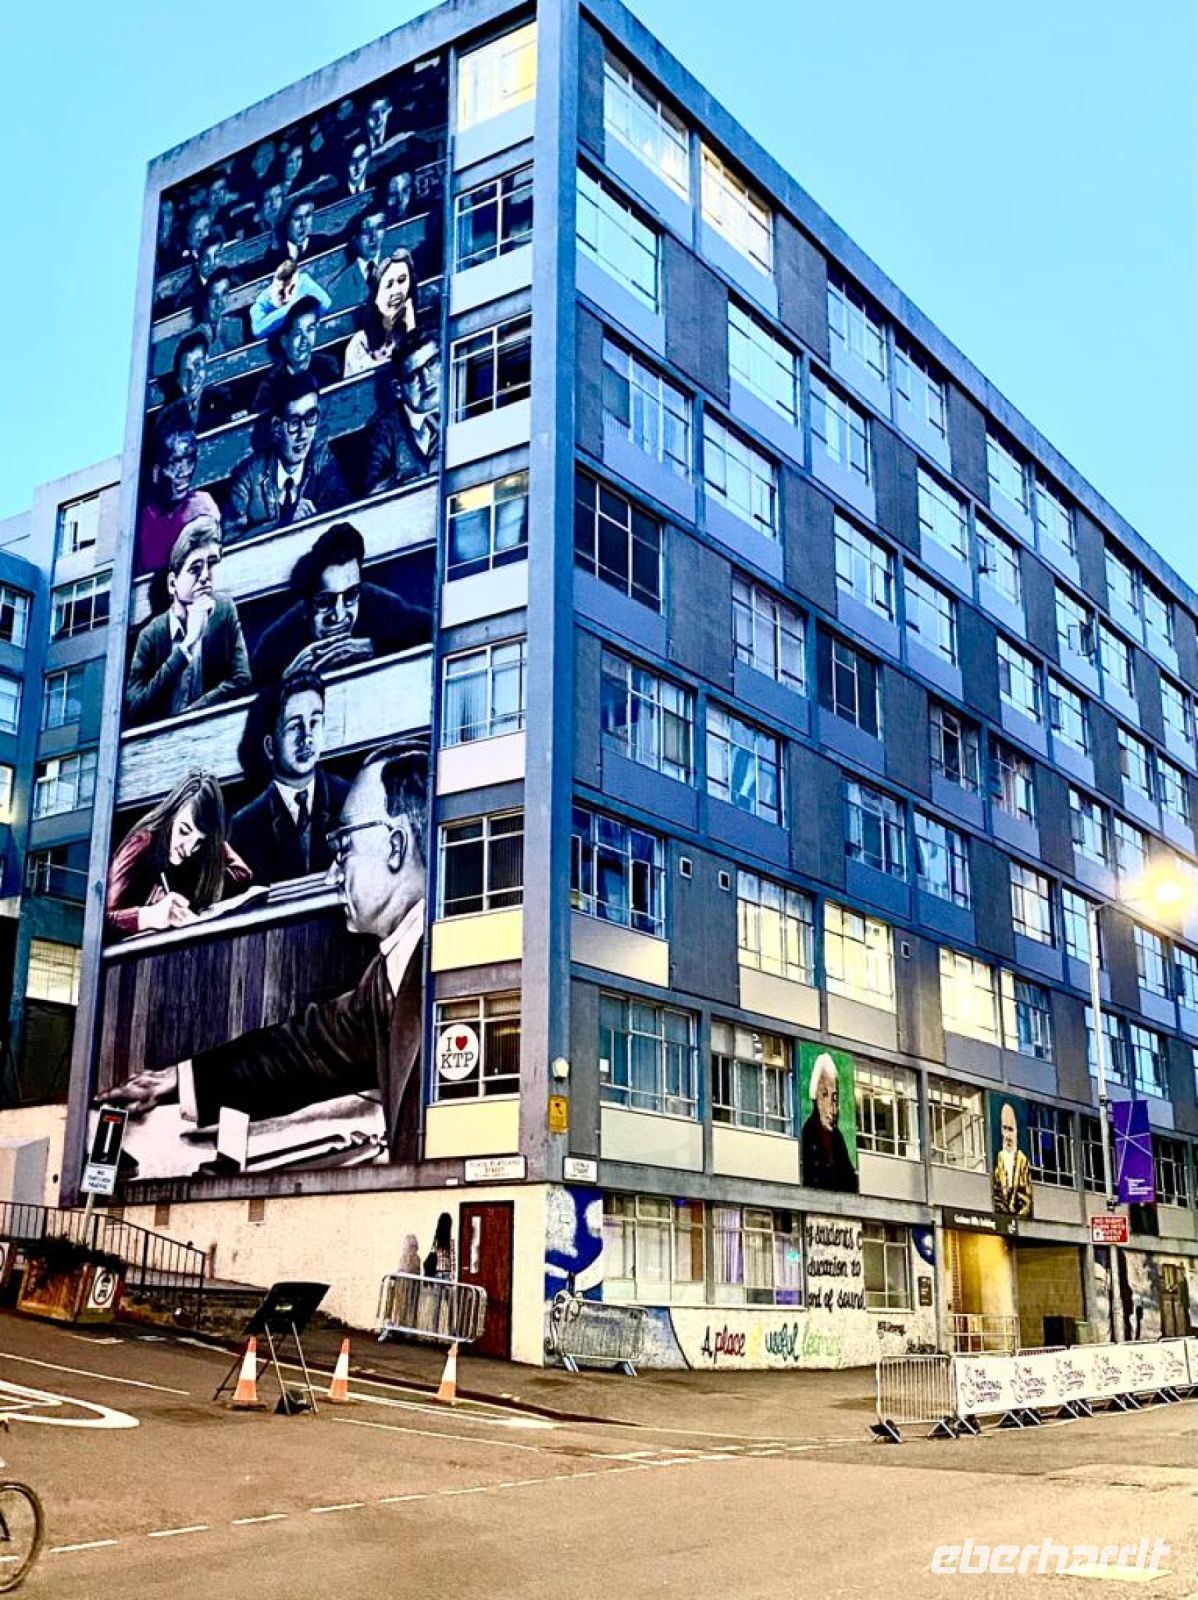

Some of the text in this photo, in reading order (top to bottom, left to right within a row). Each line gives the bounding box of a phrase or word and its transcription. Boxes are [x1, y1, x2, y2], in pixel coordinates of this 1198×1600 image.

[447, 1036, 452, 1052] I
[441, 1051, 474, 1069] KTP
[815, 1223, 854, 1250] students
[851, 1257, 861, 1277] to
[824, 1288, 834, 1313] of
[701, 1325, 712, 1358] A
[713, 1324, 745, 1364] place
[765, 1322, 799, 1361] useful
[974, 1368, 987, 1379] THE
